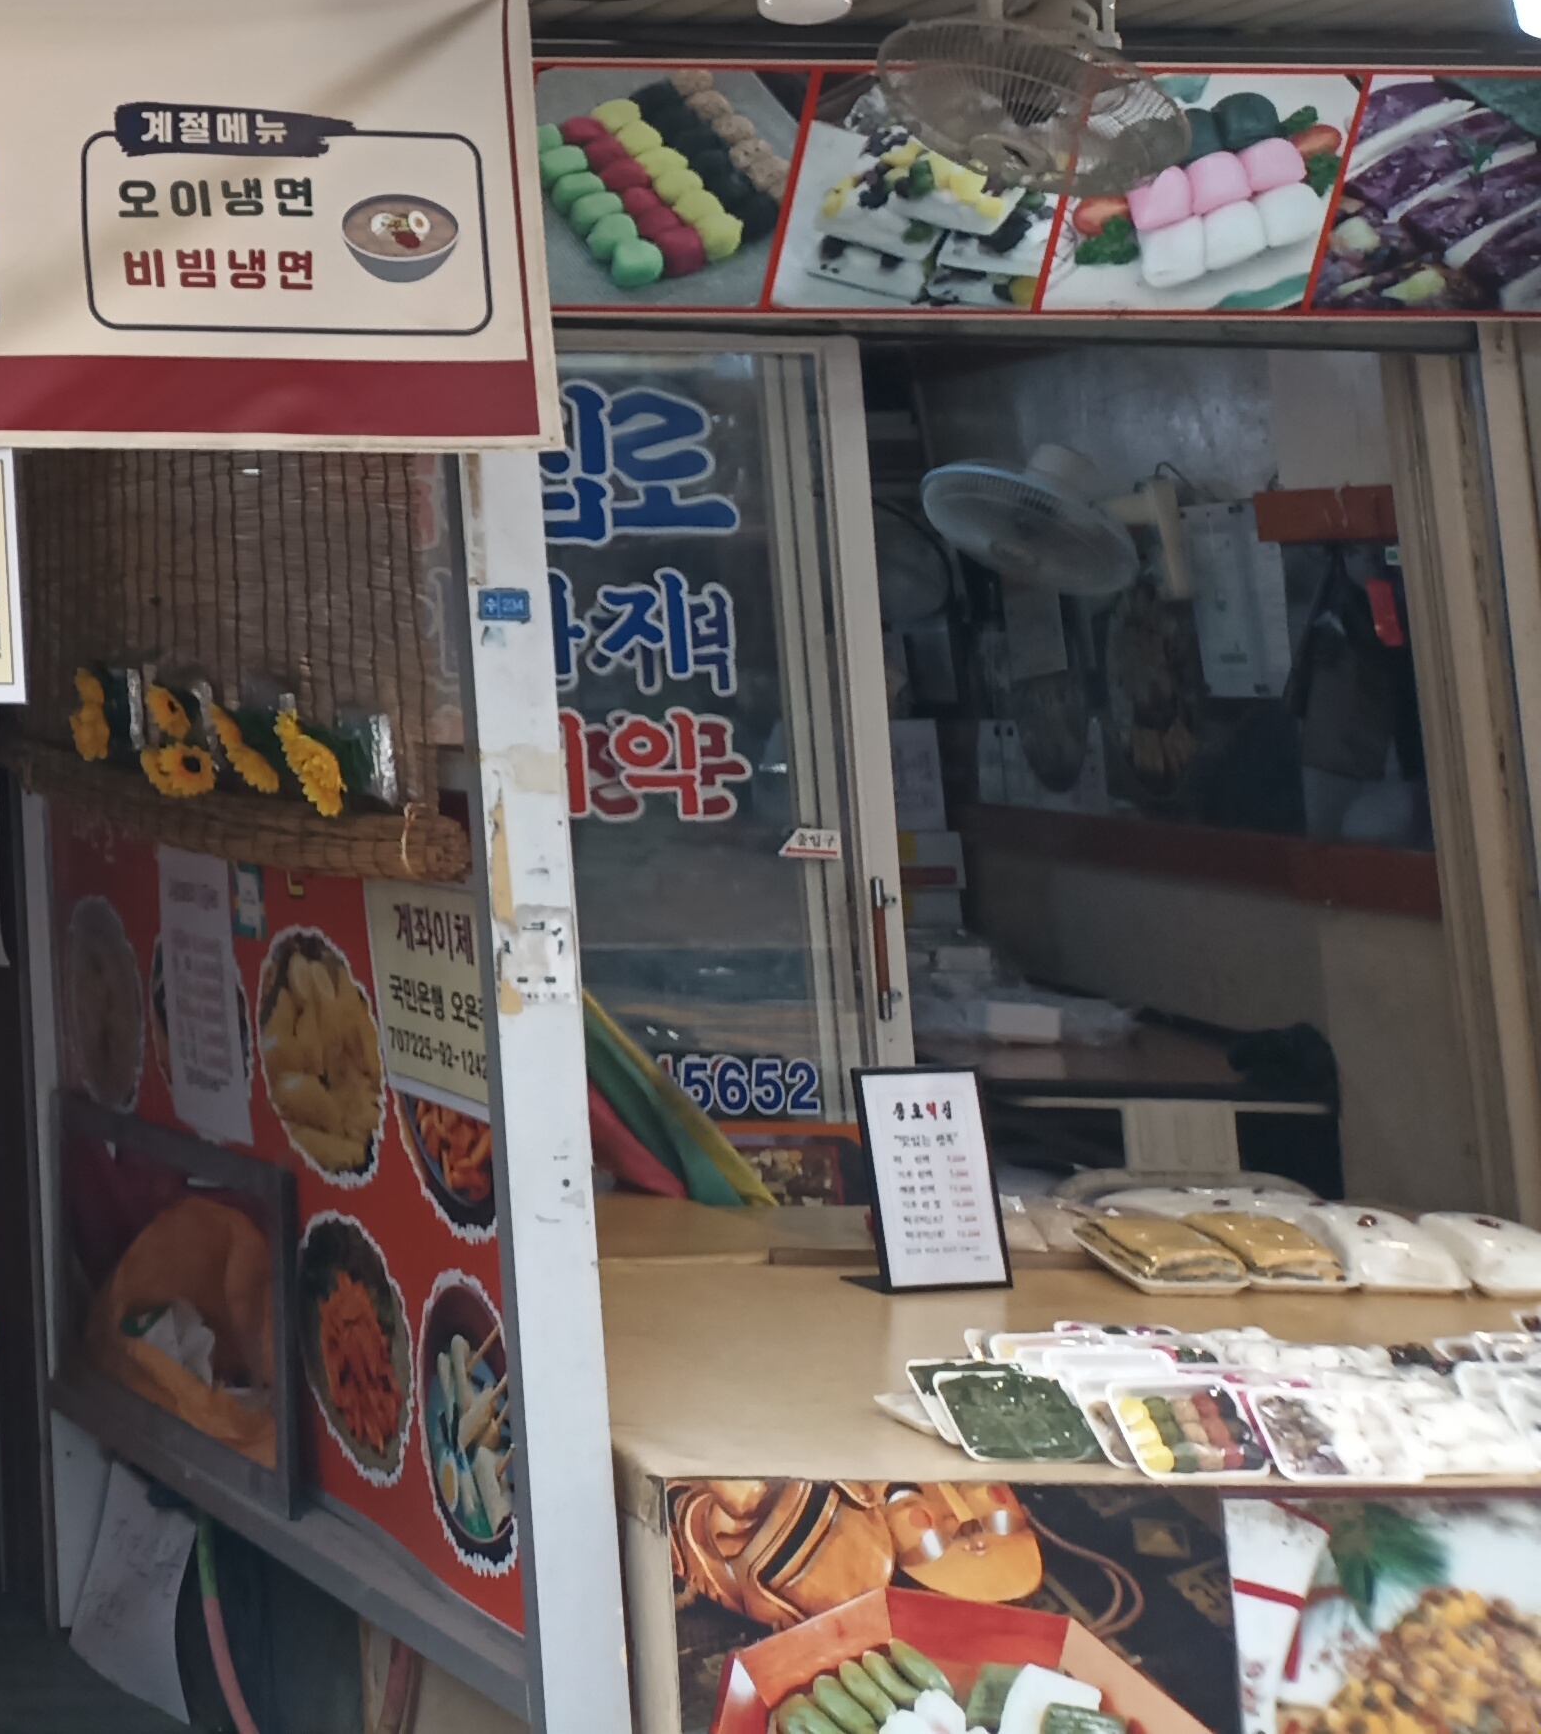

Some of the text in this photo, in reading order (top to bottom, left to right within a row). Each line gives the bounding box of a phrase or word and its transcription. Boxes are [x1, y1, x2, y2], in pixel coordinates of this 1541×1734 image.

[140, 110, 288, 145] 계절메뉴
[118, 177, 314, 219] 오이냉면
[123, 248, 314, 291] 비빔냉면
[393, 903, 475, 967] 계좌이체
[451, 990, 484, 1032] 오은
